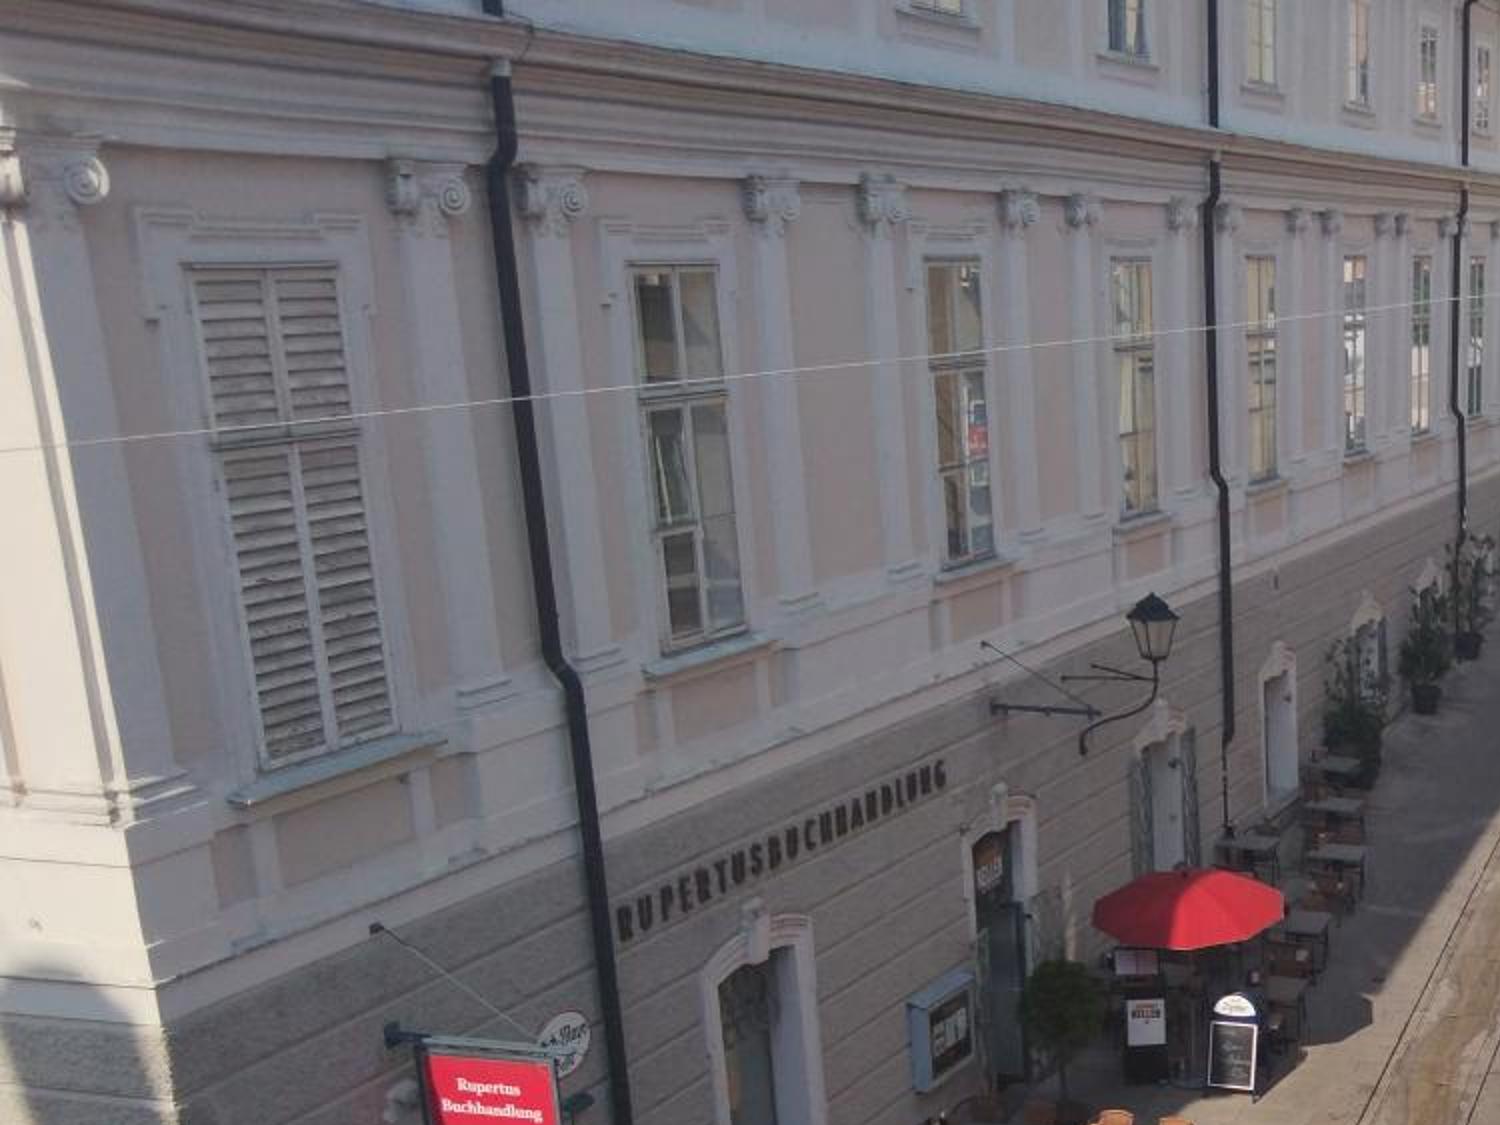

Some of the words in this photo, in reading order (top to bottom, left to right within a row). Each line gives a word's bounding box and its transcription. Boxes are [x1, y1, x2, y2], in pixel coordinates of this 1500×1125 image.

[616, 759, 947, 943] RUPERTUSBUCHHANDLUNG
[456, 1077, 521, 1097] Rupertus
[441, 1098, 543, 1123] Buchhandlung
